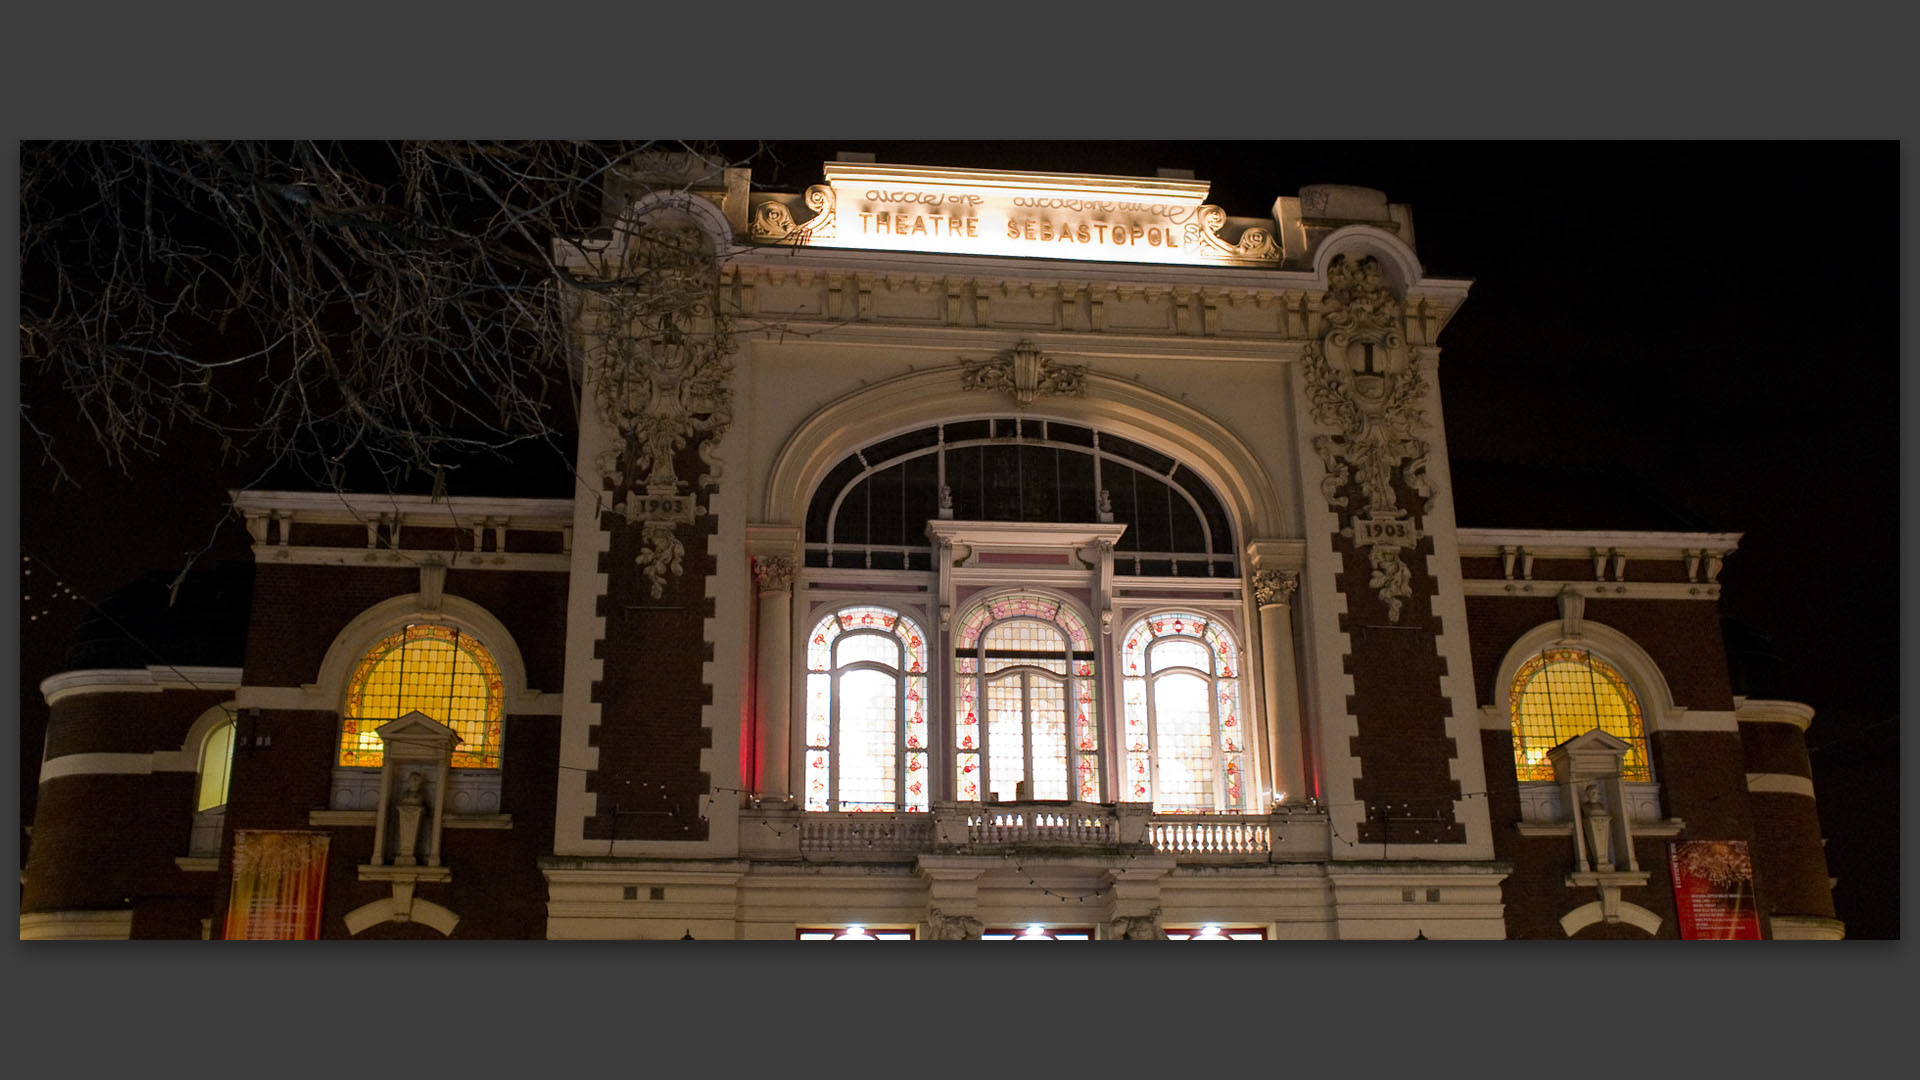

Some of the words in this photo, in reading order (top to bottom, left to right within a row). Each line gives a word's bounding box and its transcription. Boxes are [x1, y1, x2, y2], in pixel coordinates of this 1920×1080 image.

[858, 212, 980, 238] THEATRE
[1007, 219, 1179, 248] SEBASTOPOL
[640, 499, 683, 514] 1903
[1365, 523, 1406, 538] 1903
